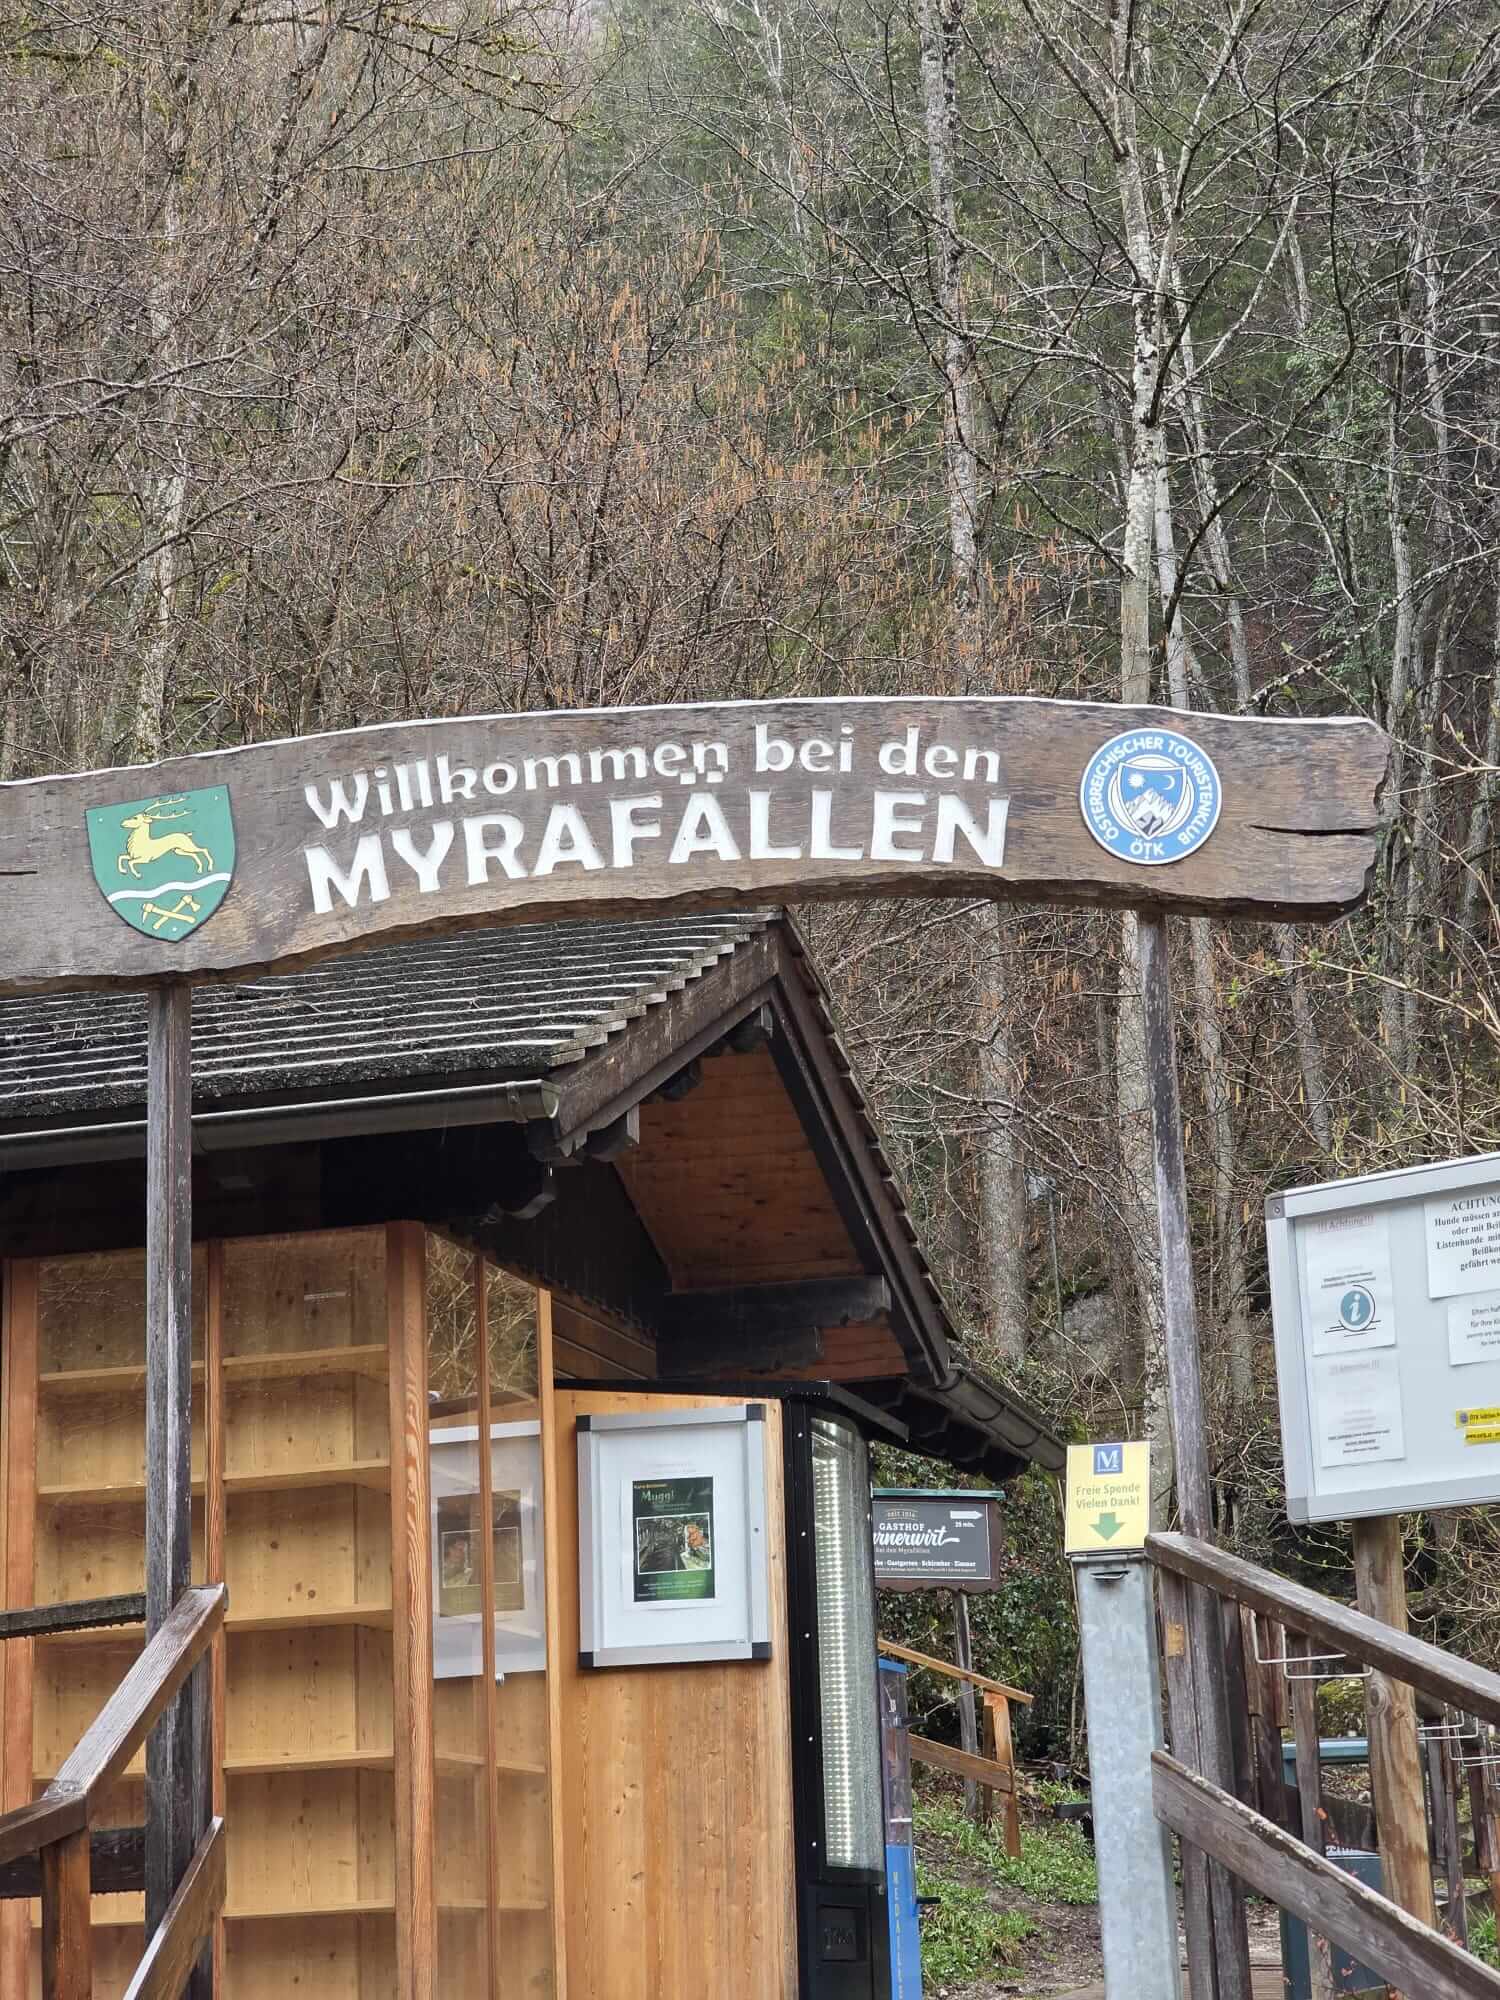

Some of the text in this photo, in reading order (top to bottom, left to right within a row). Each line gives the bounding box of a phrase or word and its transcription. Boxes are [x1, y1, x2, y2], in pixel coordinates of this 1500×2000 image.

[303, 721, 1001, 829] Willkommen bei den
[1089, 736, 1213, 845] ÖSTERREICHISCHER TOURISTENKLUB
[303, 770, 1010, 914] MYRAFÄLLEN
[1130, 838, 1165, 857] ÖTK
[1435, 1216, 1460, 1227] Hunde
[1452, 1226, 1469, 1236] oder
[1471, 1223, 1484, 1233] mit
[1437, 1235, 1483, 1250] Listenhunde
[1075, 1482, 1141, 1496] Freie Spende
[1075, 1495, 1140, 1509] Vielen Dank!
[879, 1522, 926, 1532] GASTHOF
